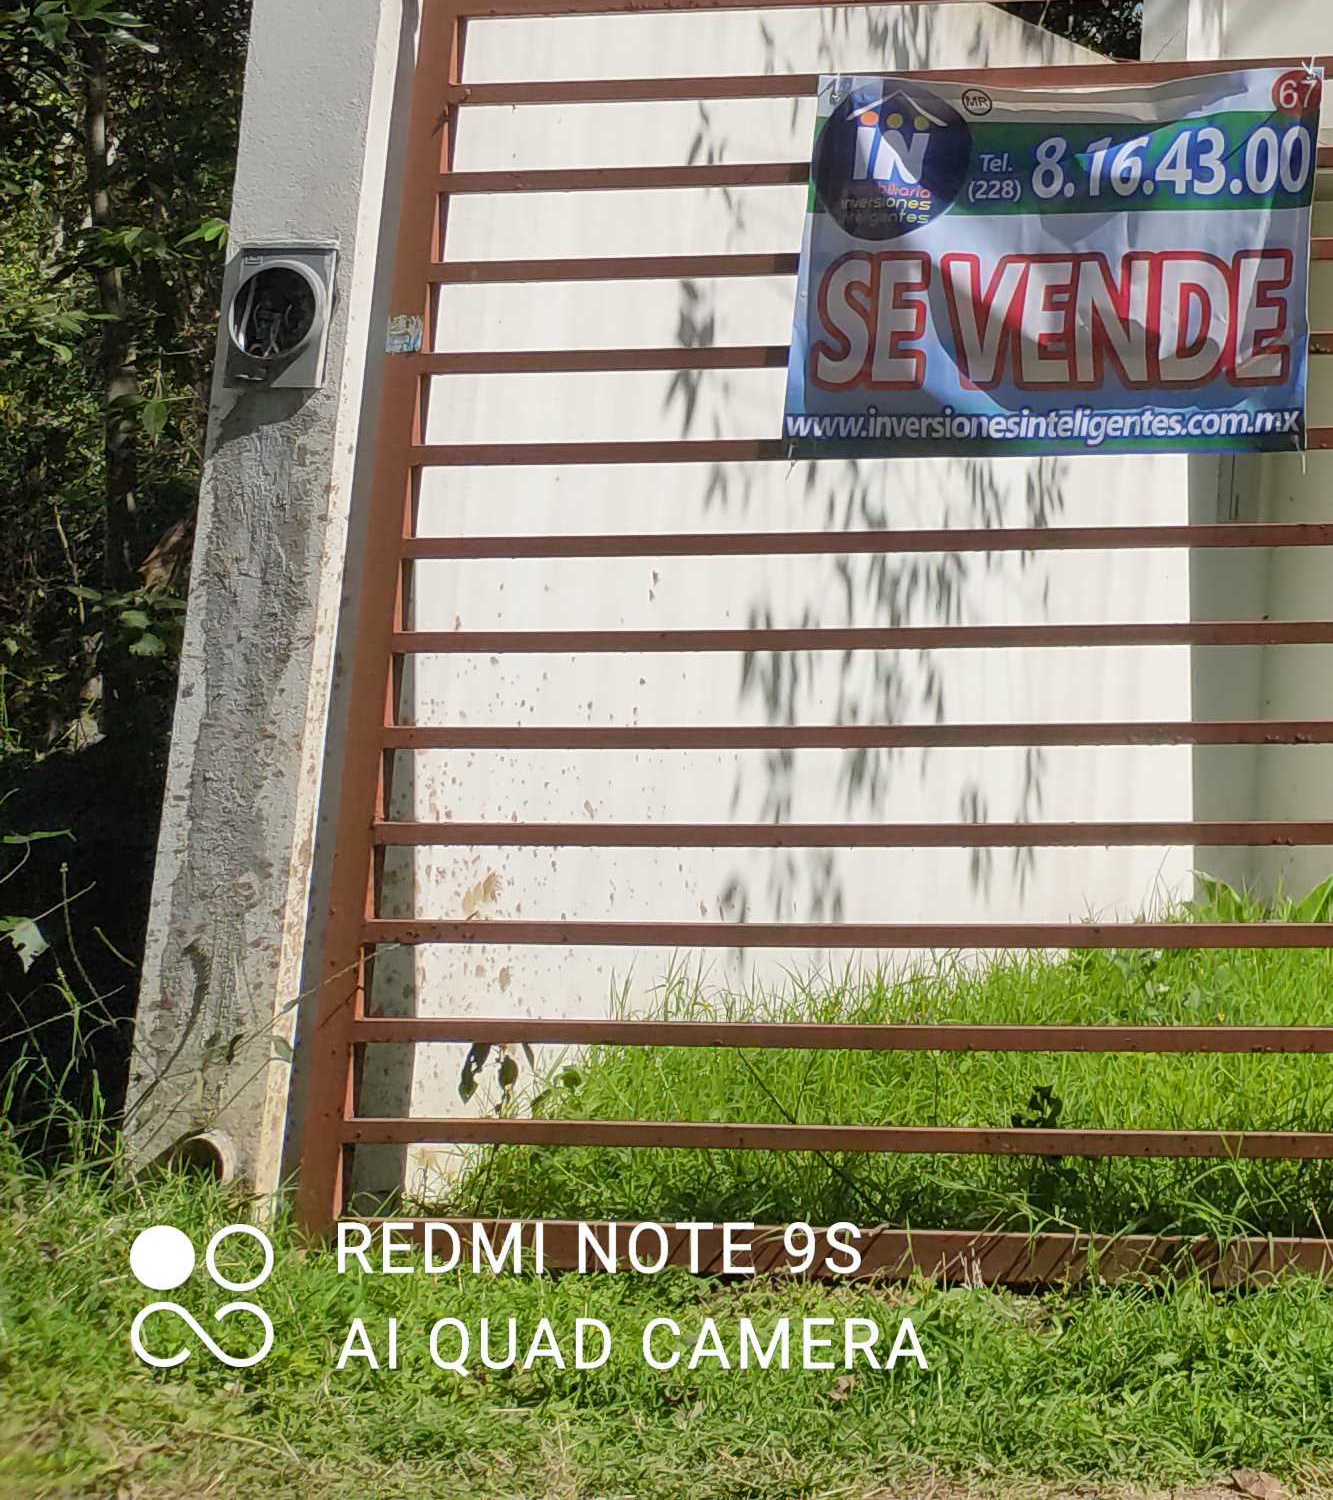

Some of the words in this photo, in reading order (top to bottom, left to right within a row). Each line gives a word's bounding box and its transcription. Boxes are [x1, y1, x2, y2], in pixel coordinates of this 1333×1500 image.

[965, 96, 989, 109] MR
[1279, 79, 1317, 109] 67
[979, 152, 1014, 173] Tel.
[1031, 125, 1312, 199] 8.16.43.00
[968, 180, 1022, 203] (228)
[809, 251, 931, 391] SE
[940, 251, 1294, 391] VENDE
[786, 408, 1300, 446] www.inversionesinteligentes.com.mx
